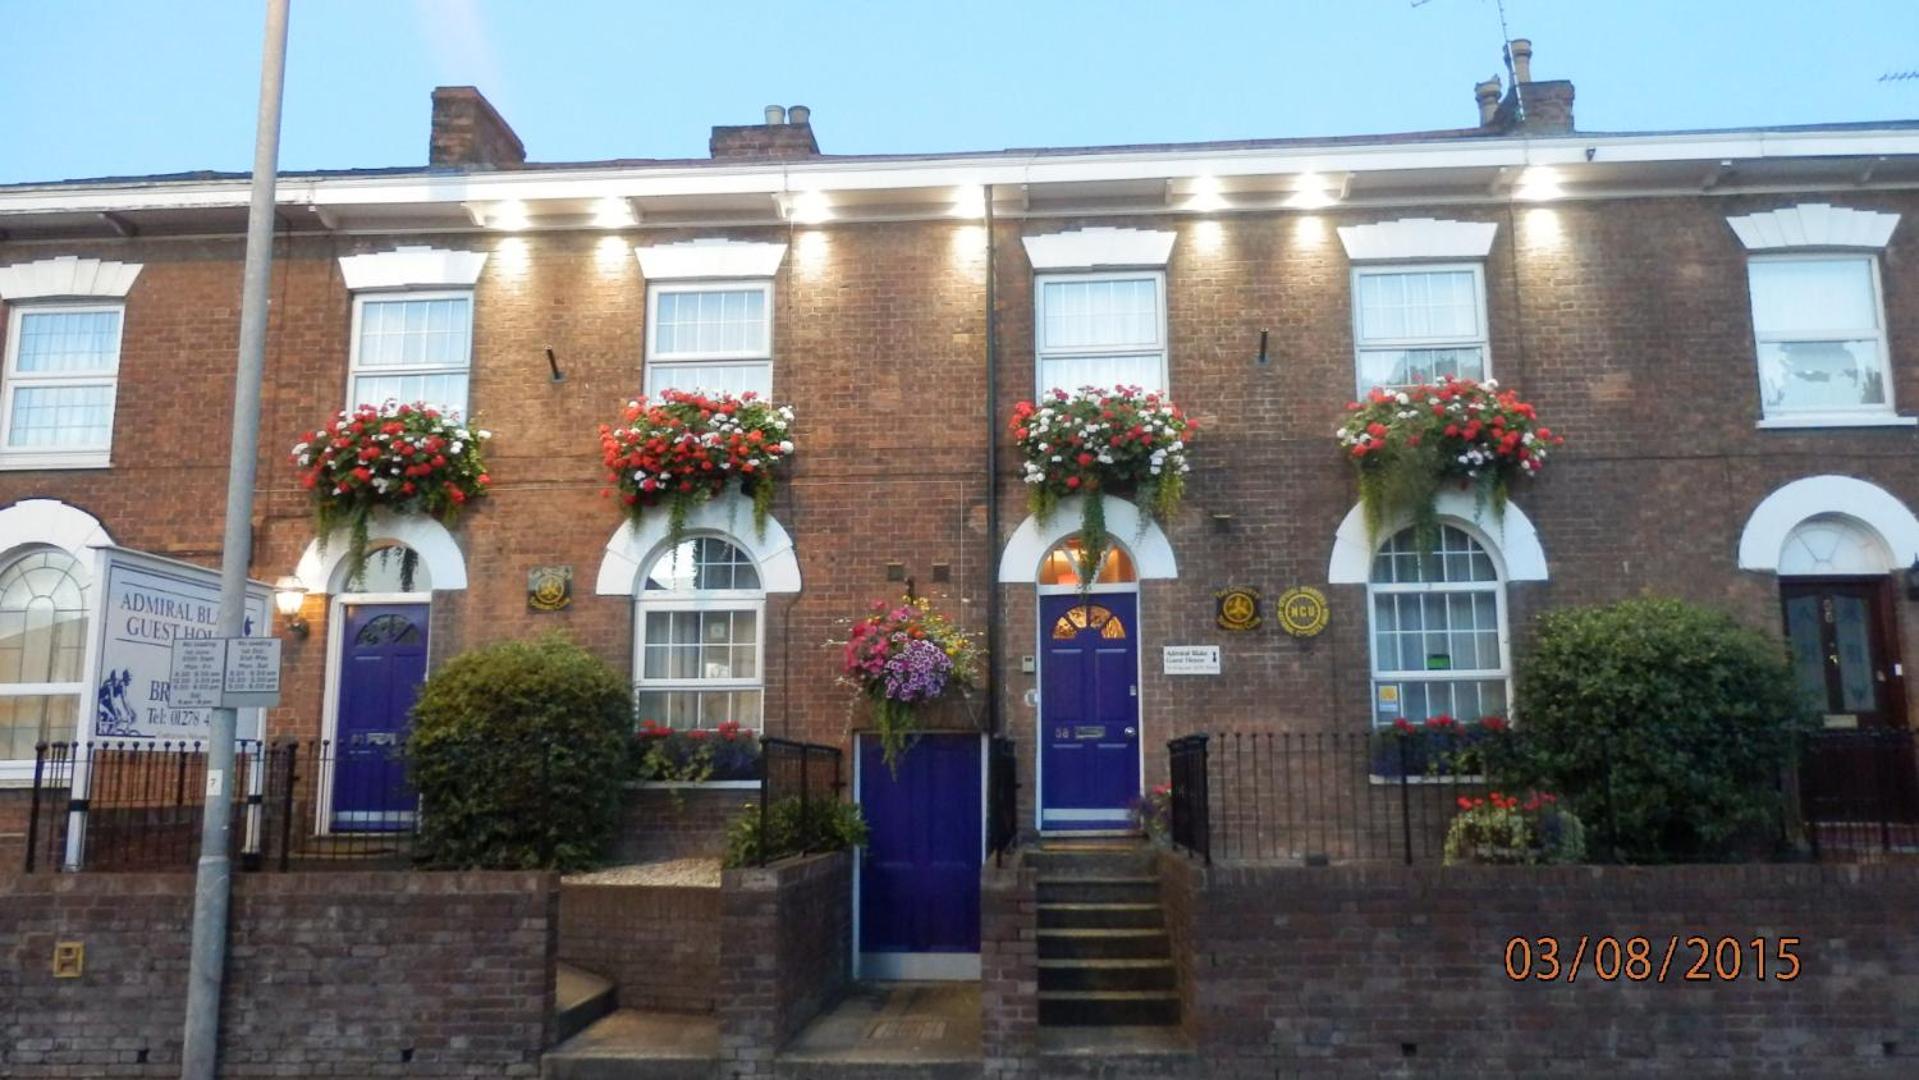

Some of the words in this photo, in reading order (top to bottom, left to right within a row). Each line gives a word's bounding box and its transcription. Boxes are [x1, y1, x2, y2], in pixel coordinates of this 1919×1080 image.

[120, 592, 193, 621] ADMIRAL
[197, 605, 217, 625] BL
[126, 616, 180, 641] GUEST
[170, 710, 200, 727] 01278
